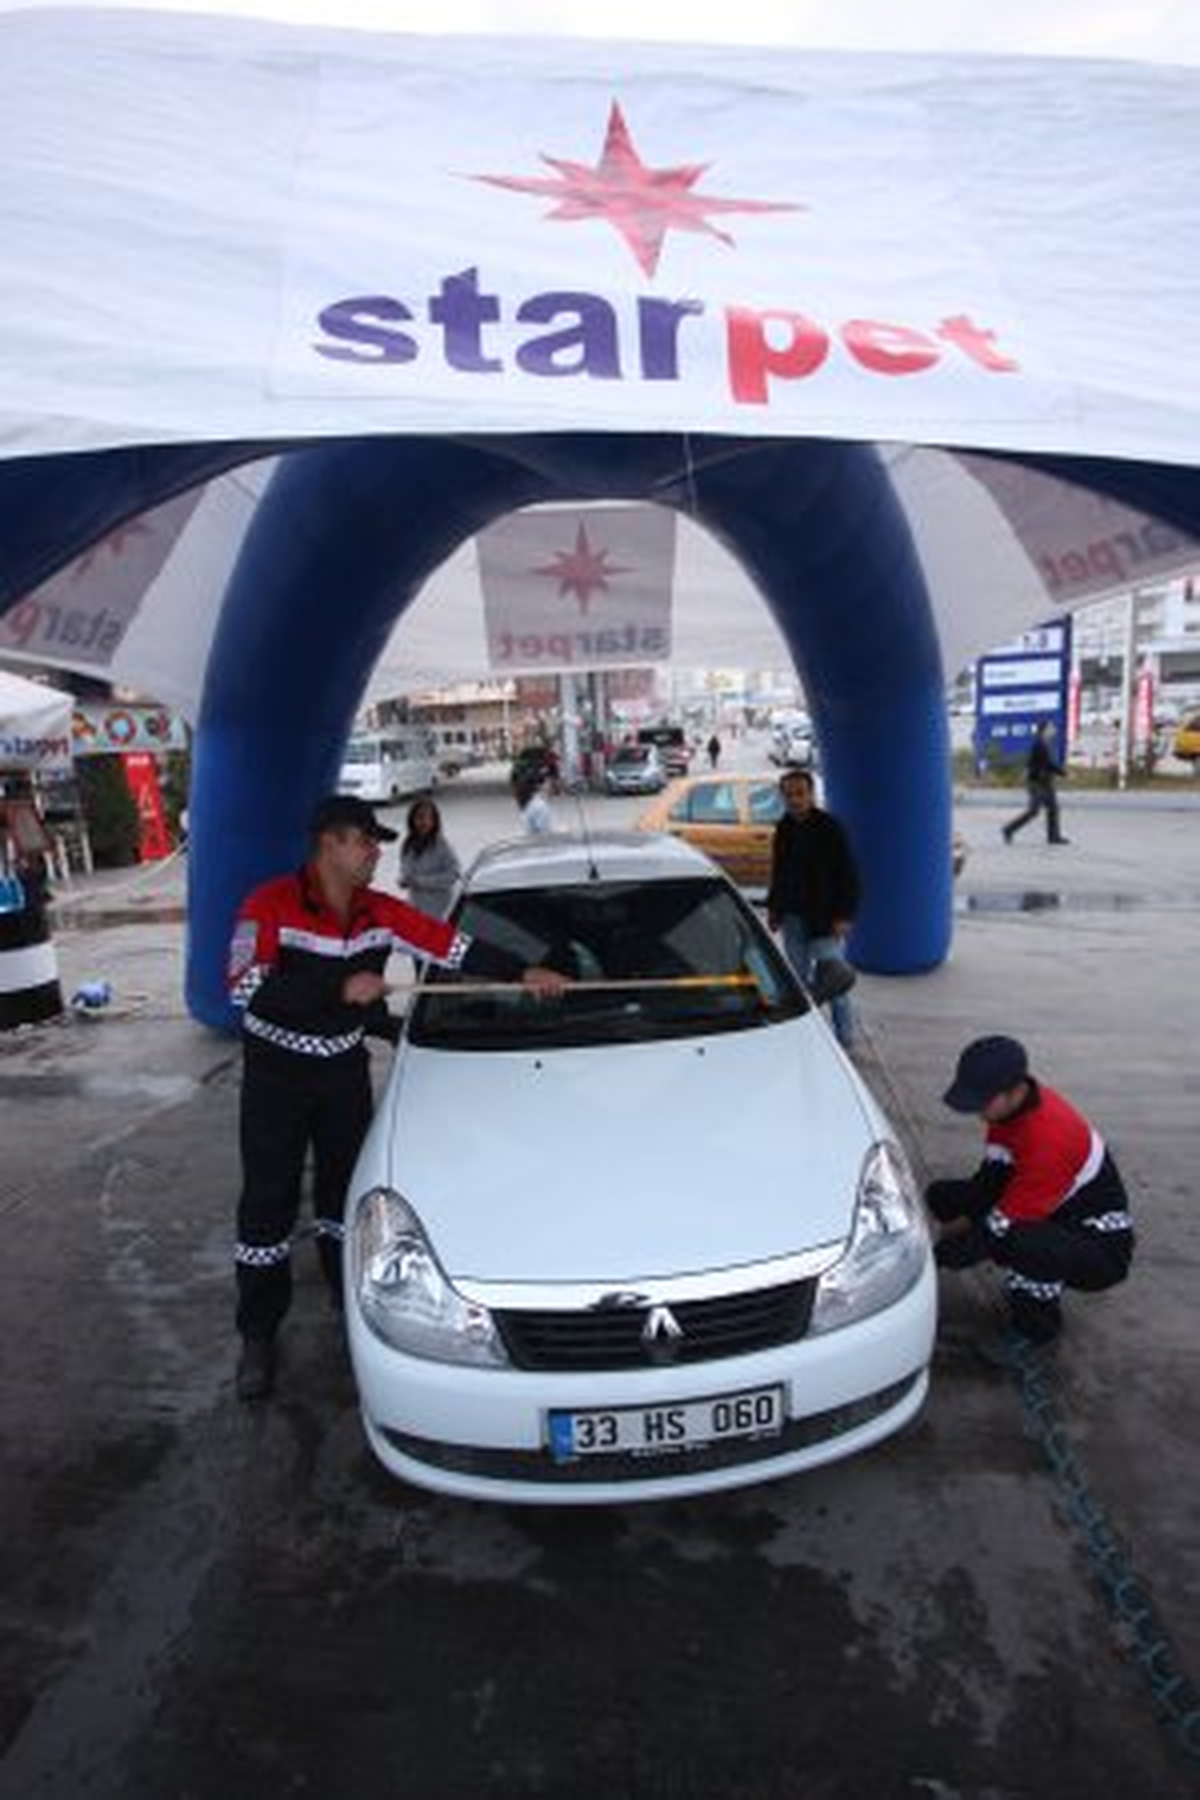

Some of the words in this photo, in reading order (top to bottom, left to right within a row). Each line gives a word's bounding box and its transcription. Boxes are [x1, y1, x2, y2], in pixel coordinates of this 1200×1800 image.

[312, 266, 1021, 405] starpet
[576, 1415, 618, 1449] 33
[644, 1410, 685, 1442] HS
[712, 1395, 774, 1434] 060
